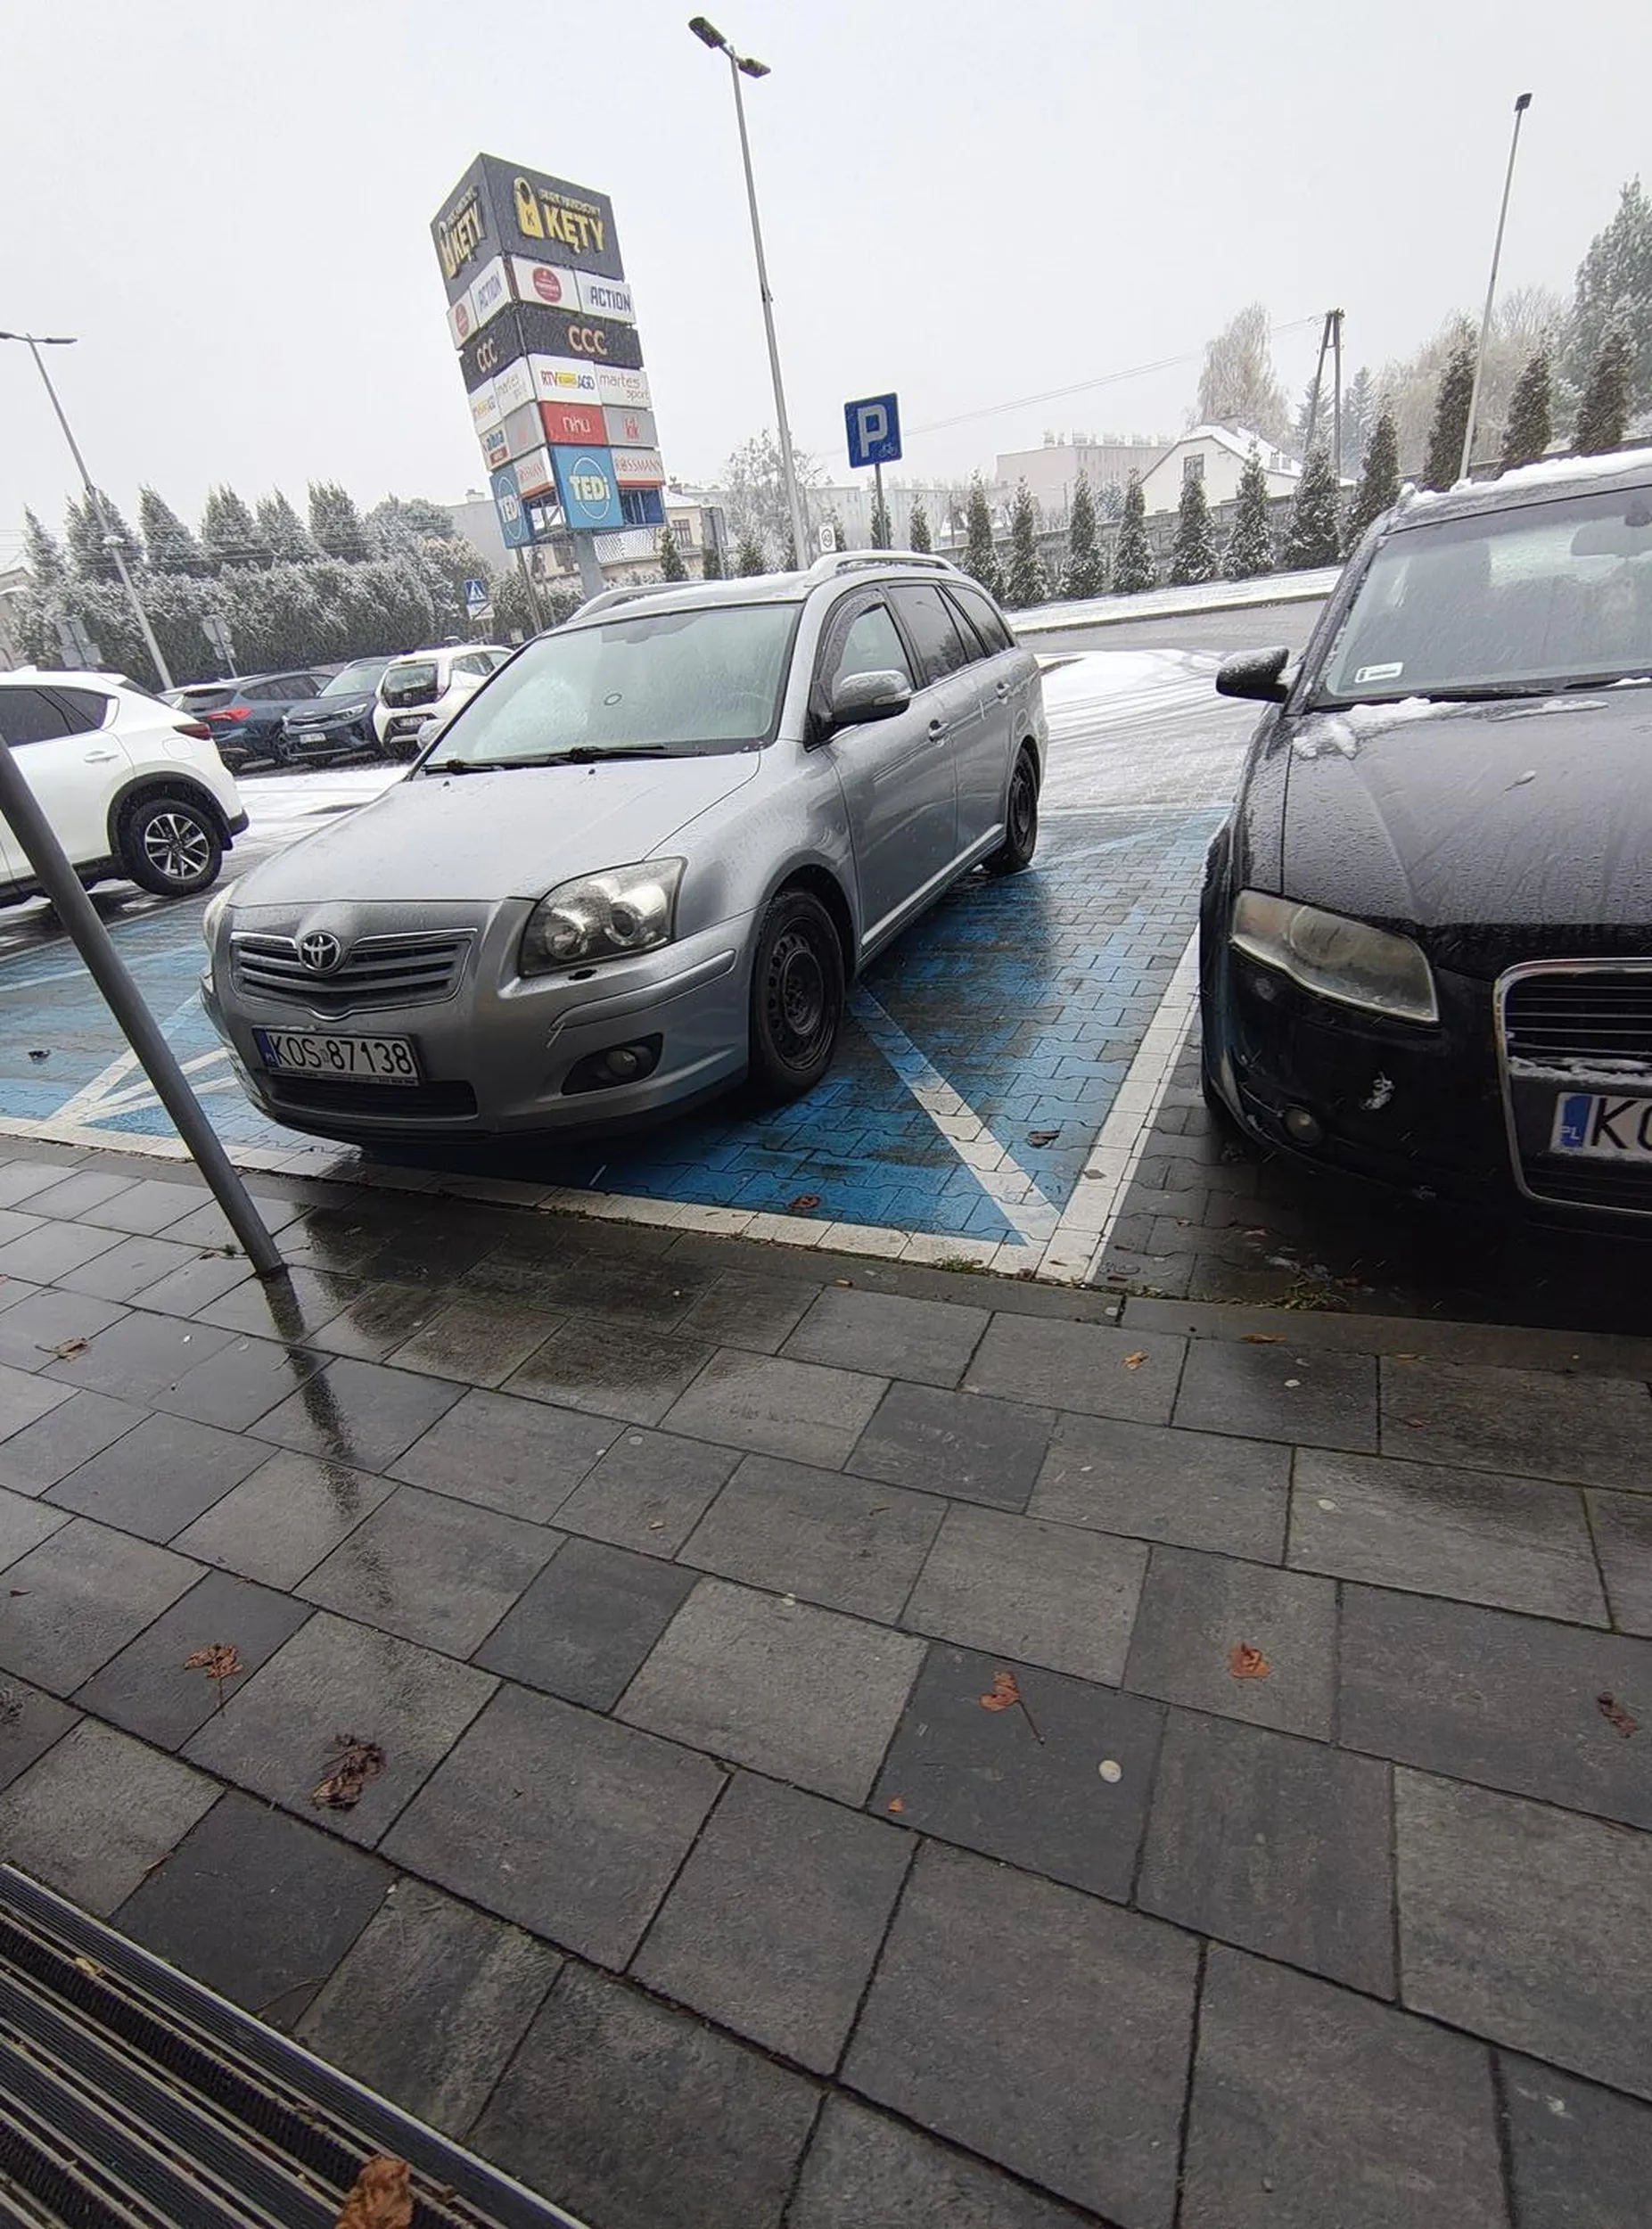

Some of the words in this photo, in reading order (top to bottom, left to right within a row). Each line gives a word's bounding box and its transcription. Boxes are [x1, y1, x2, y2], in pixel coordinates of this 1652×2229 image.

[544, 203, 604, 253] KĘTY
[590, 285, 631, 312] ACTION
[477, 337, 497, 373] CCC
[569, 325, 607, 355] CCC
[599, 373, 640, 389] martes
[857, 404, 887, 458] P
[269, 1034, 322, 1068] KOS
[326, 1040, 413, 1075] 87138
[1560, 1125, 1581, 1140] PL
